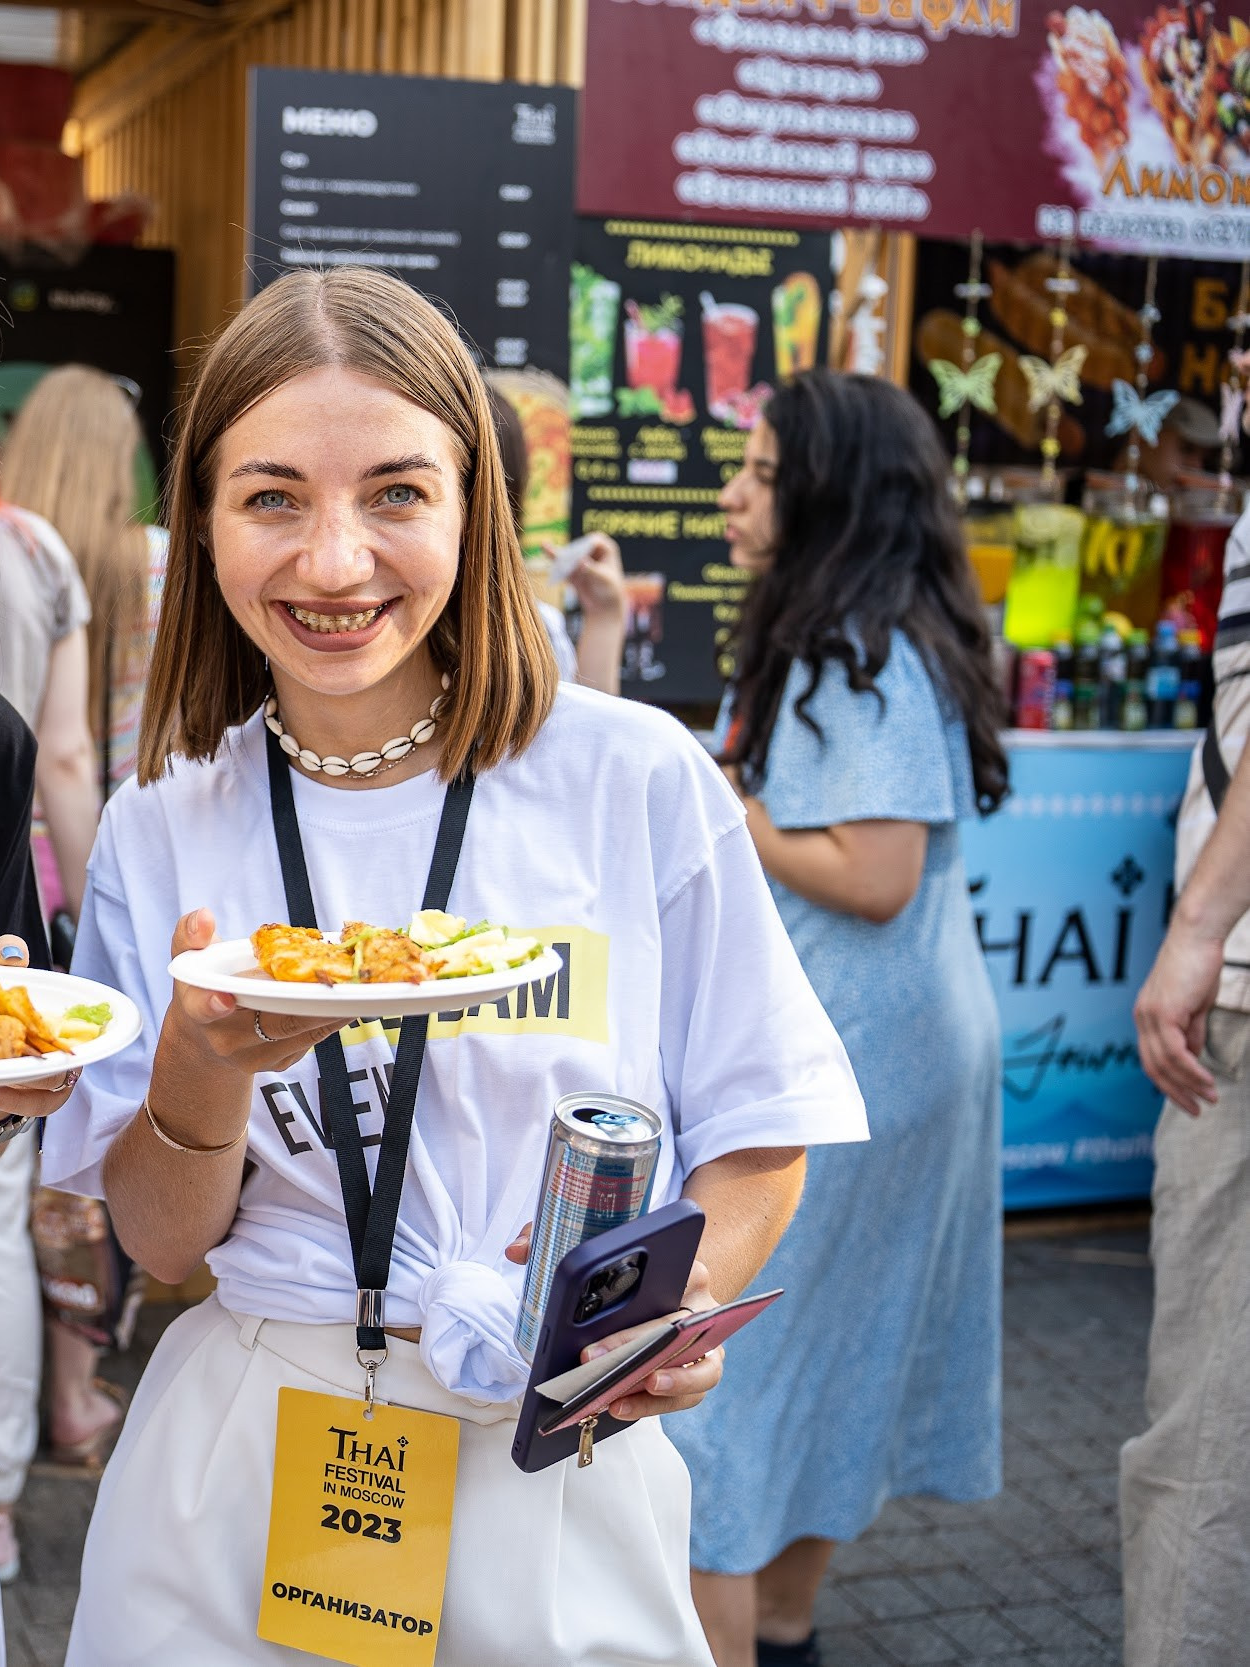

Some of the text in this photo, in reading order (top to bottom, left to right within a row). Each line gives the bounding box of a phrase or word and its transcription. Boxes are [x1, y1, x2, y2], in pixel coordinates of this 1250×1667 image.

[323, 1481, 405, 1509] IN MOSCOW
[324, 1463, 406, 1494] FESTIVAL
[320, 1503, 402, 1544] 2023
[271, 1582, 434, 1636] ОРГАНИЗАТОР
